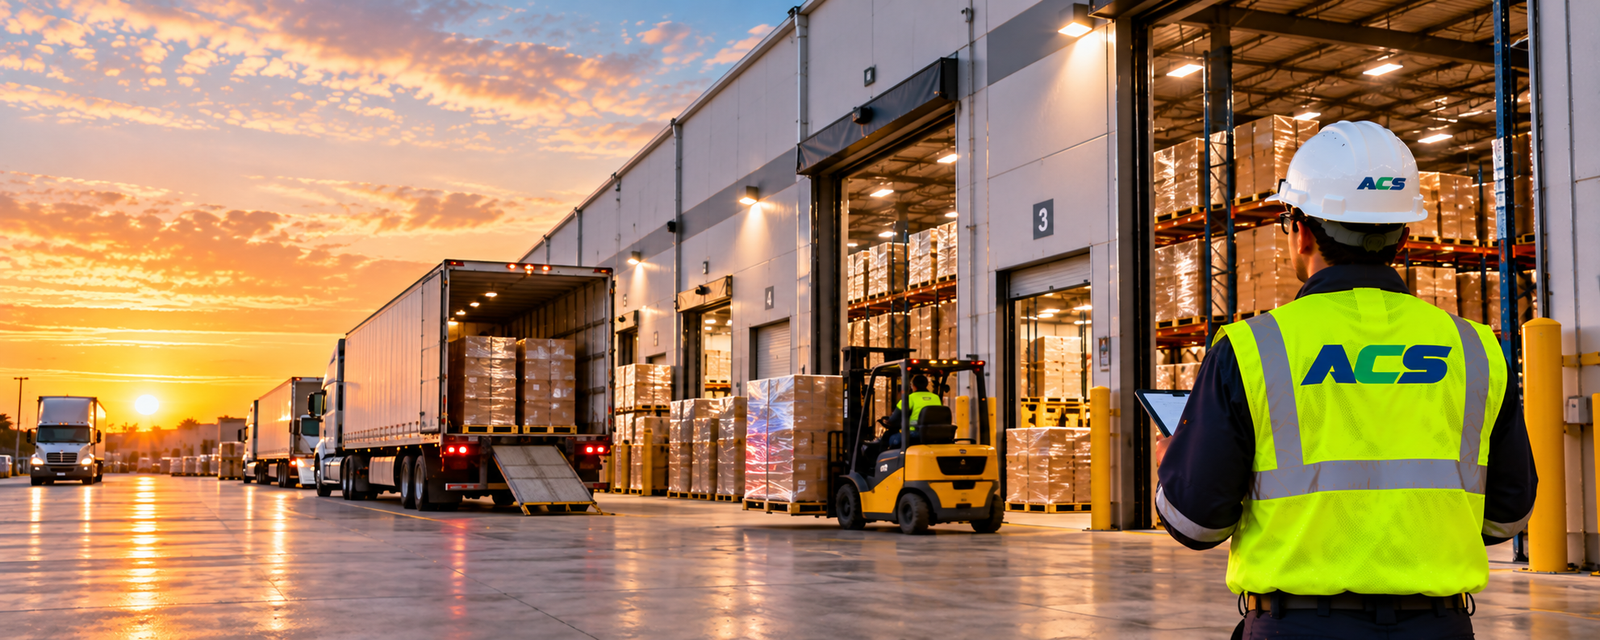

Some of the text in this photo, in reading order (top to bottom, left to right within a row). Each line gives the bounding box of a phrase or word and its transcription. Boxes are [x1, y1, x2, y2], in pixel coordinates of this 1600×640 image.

[1357, 176, 1407, 191] ACS
[1038, 207, 1048, 232] 3
[1301, 344, 1452, 386] ACS
